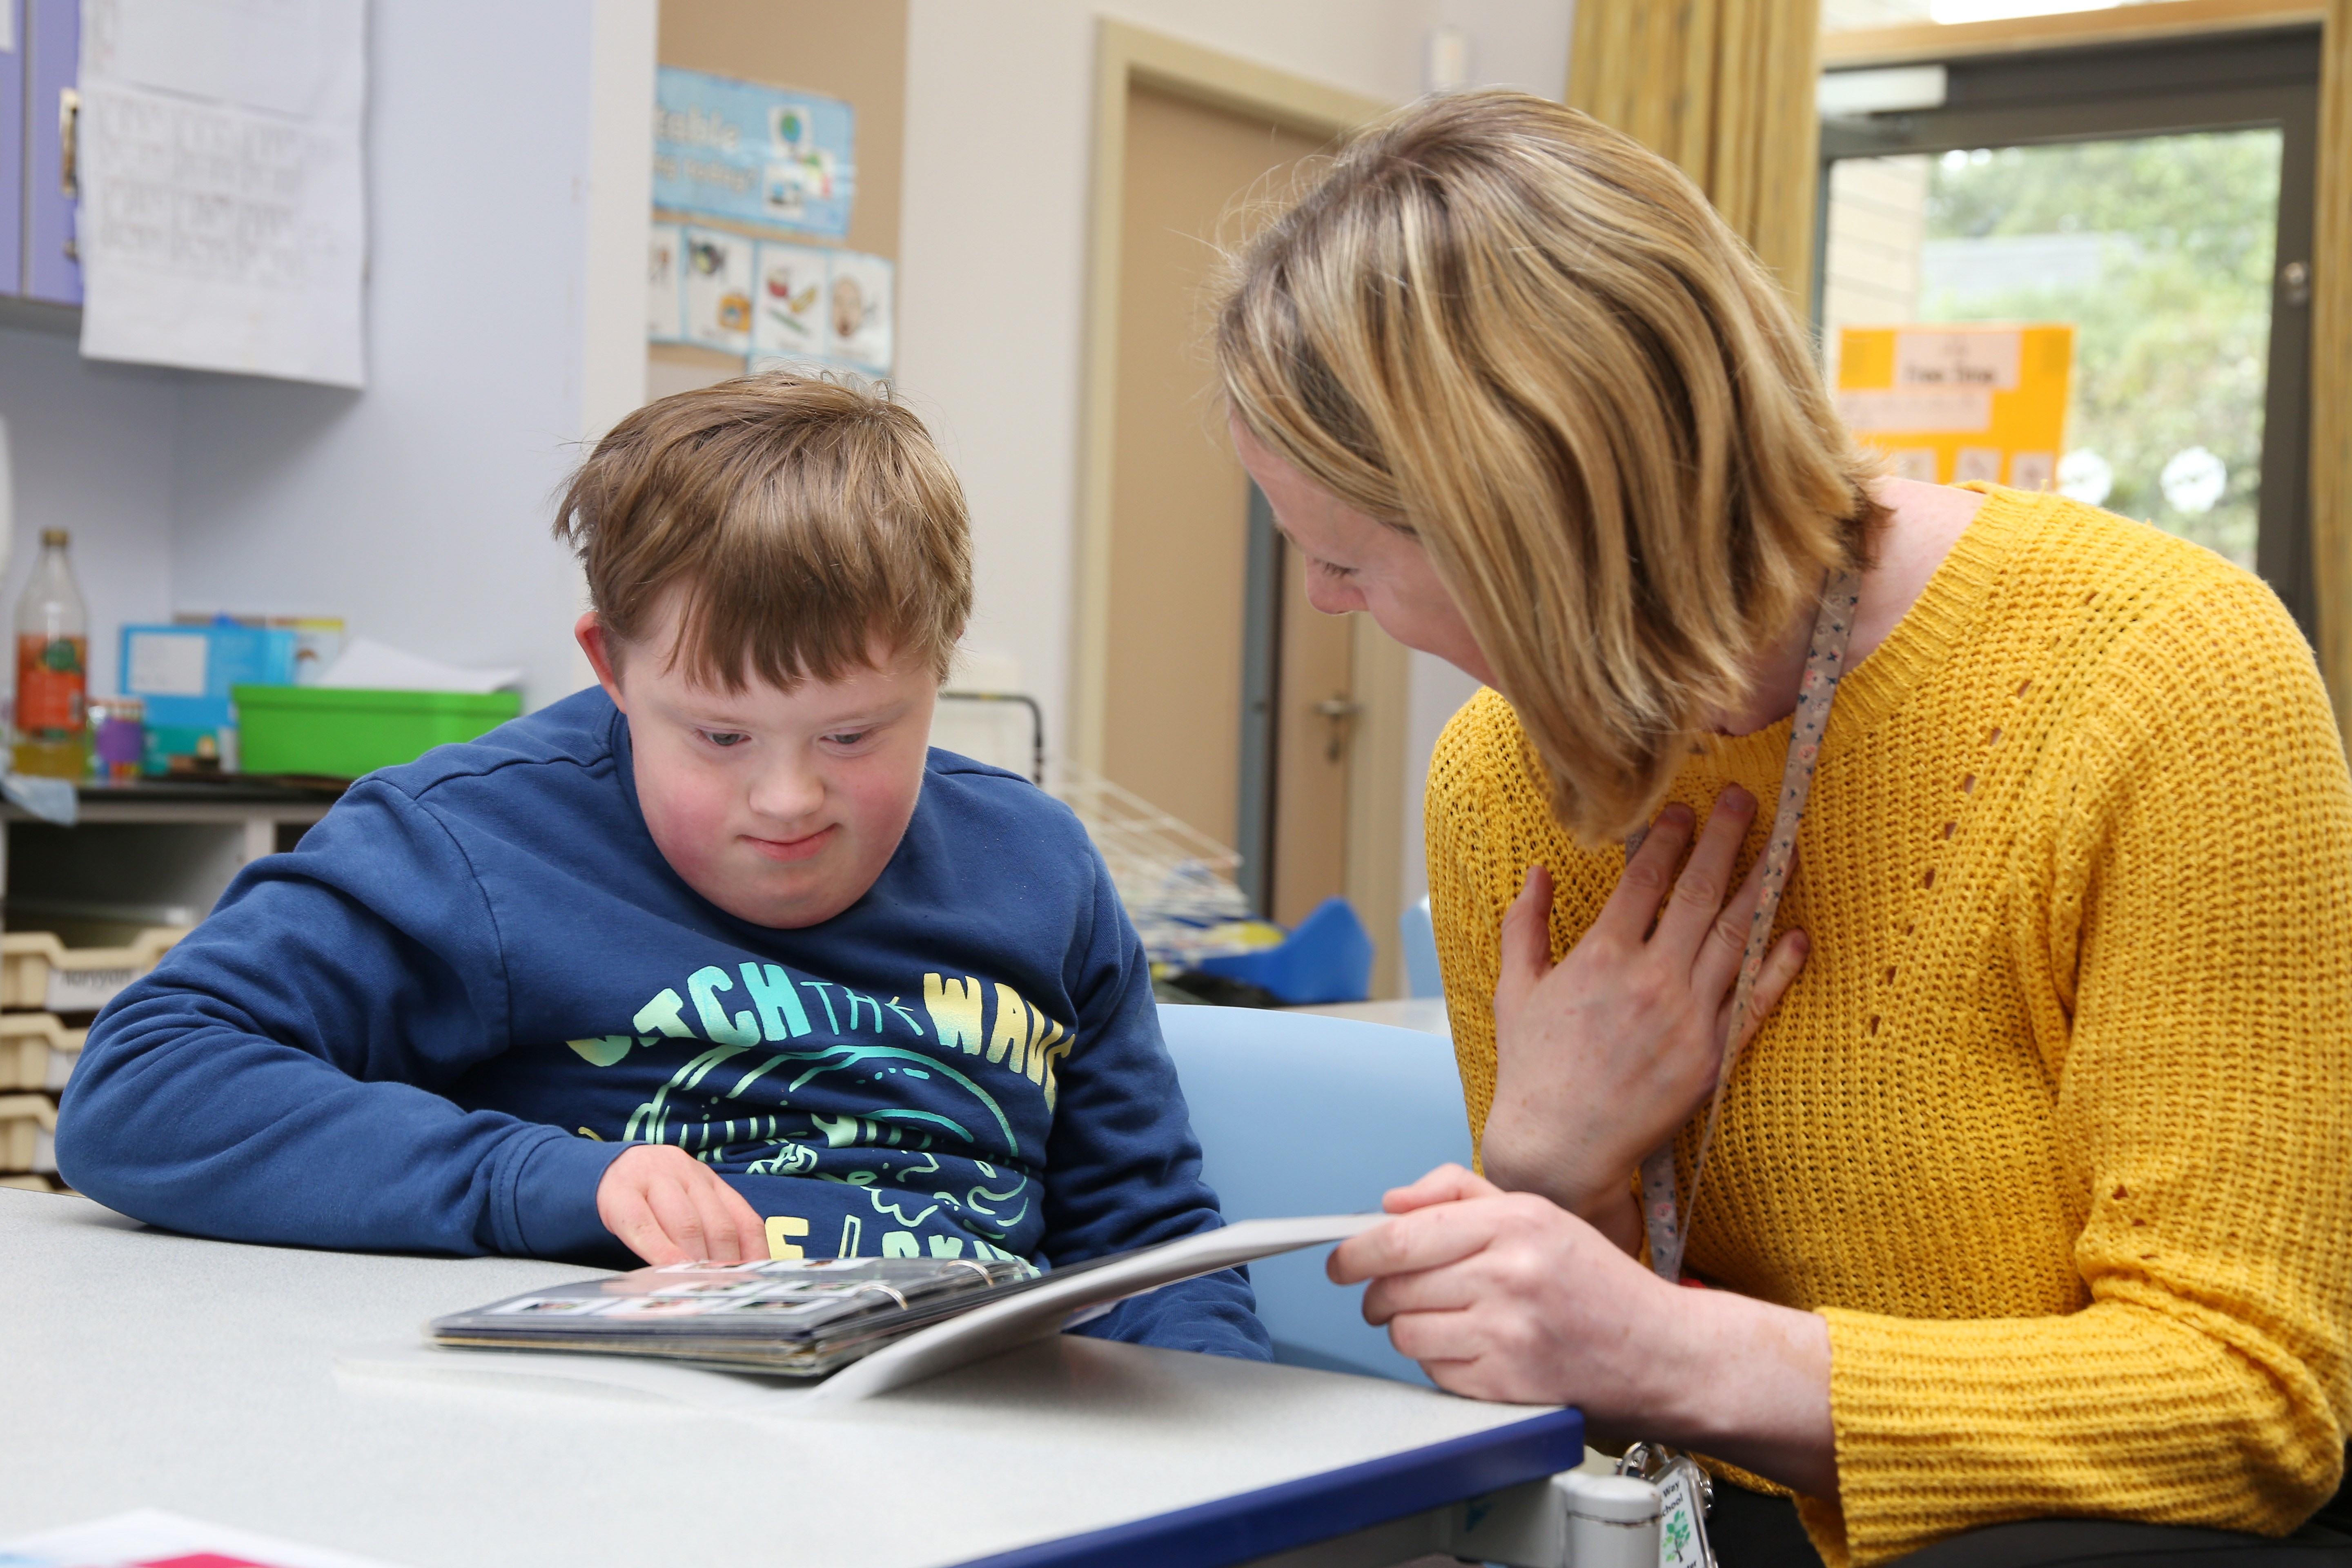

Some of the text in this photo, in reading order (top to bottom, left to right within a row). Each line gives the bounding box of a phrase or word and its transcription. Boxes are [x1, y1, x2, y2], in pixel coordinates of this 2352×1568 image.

[566, 962, 812, 1067] TCH
[1663, 1481, 1679, 1497] Way
[1660, 1493, 1683, 1518] chool
